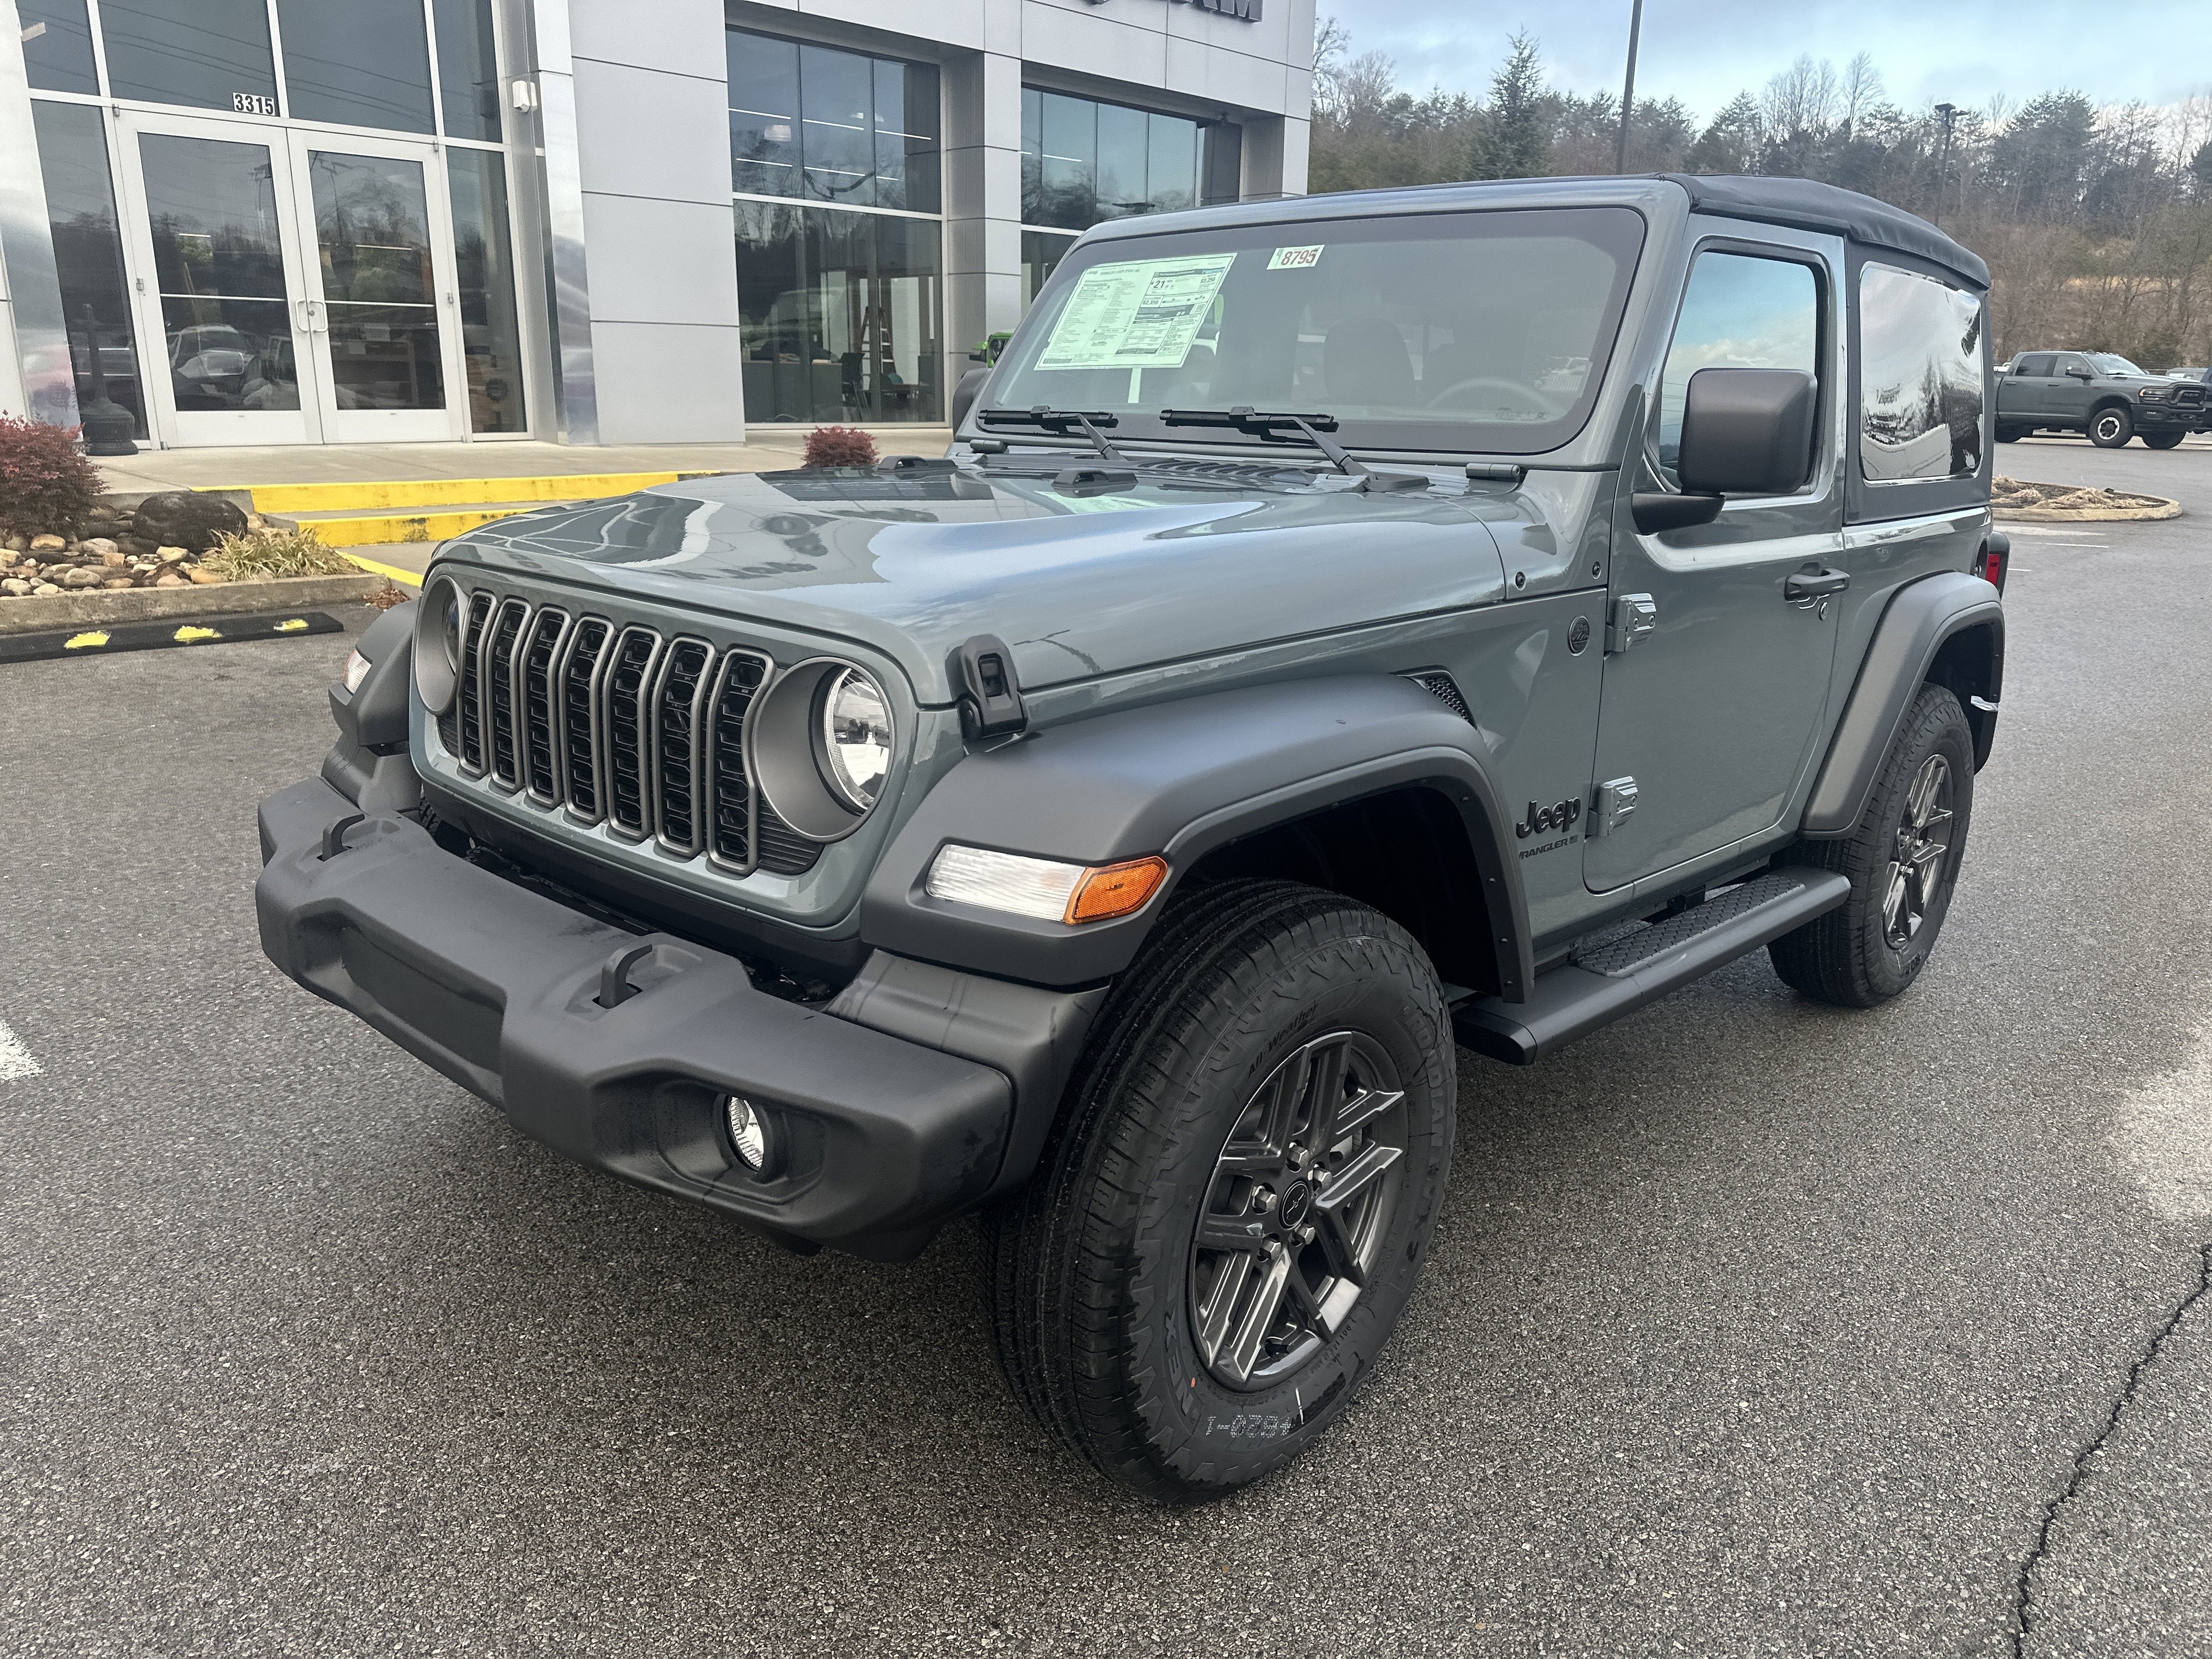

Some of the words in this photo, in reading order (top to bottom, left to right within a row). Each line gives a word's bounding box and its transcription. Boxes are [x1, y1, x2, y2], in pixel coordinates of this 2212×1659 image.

[234, 94, 274, 115] 3315
[1280, 250, 1319, 266] 8795
[1153, 280, 1166, 289] 21
[1516, 797, 1581, 839] Jeep
[1248, 1000, 1319, 1080] All-Weather
